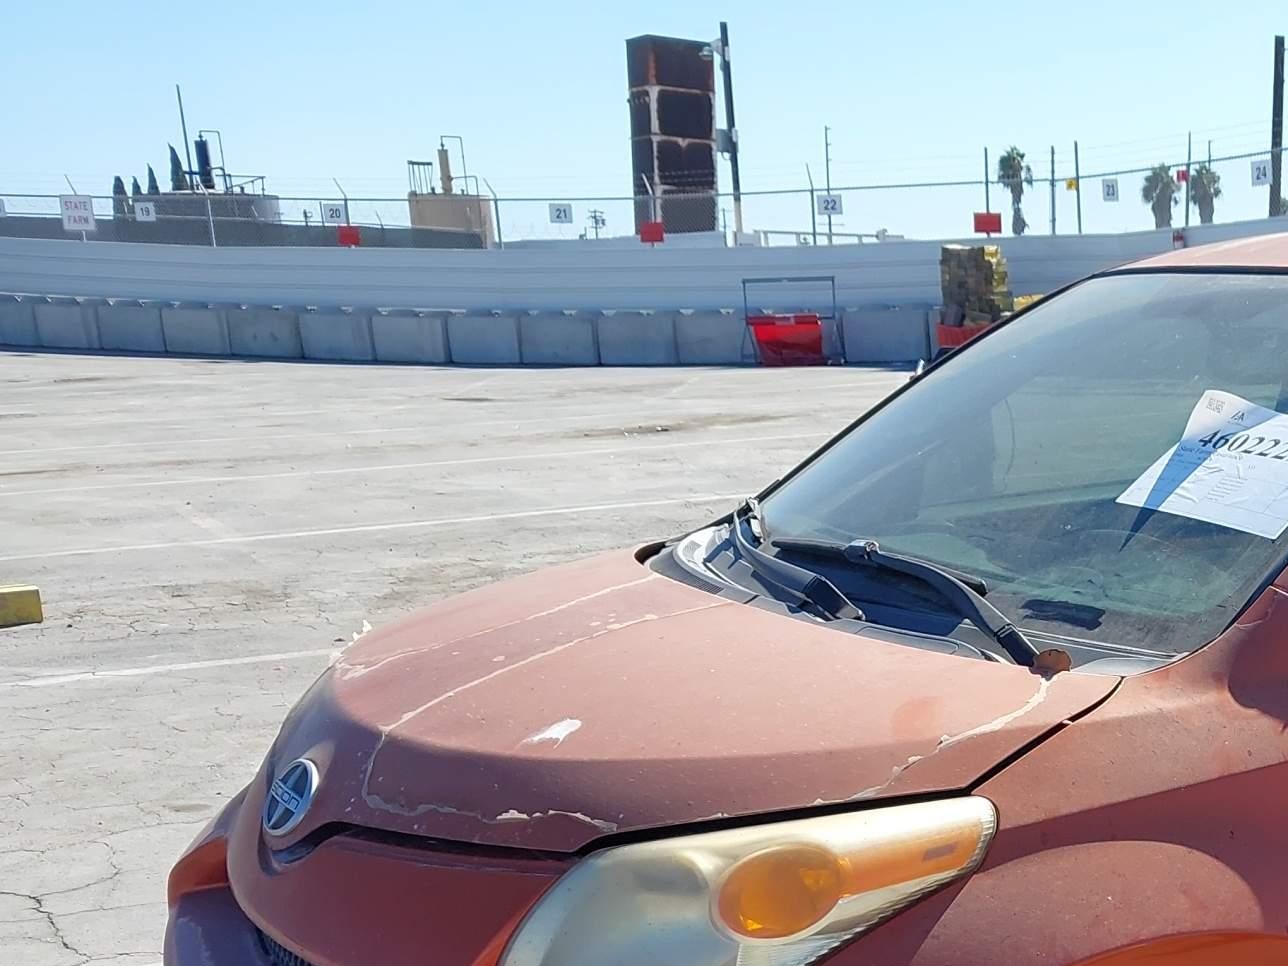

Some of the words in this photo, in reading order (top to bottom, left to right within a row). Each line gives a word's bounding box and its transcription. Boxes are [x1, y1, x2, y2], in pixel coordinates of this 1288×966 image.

[1255, 165, 1267, 181] 24
[64, 200, 88, 211] STATE
[823, 198, 837, 211] 22
[140, 206, 151, 217] 19
[328, 207, 341, 219] 20
[555, 208, 568, 220] 21
[67, 215, 90, 225] FARM
